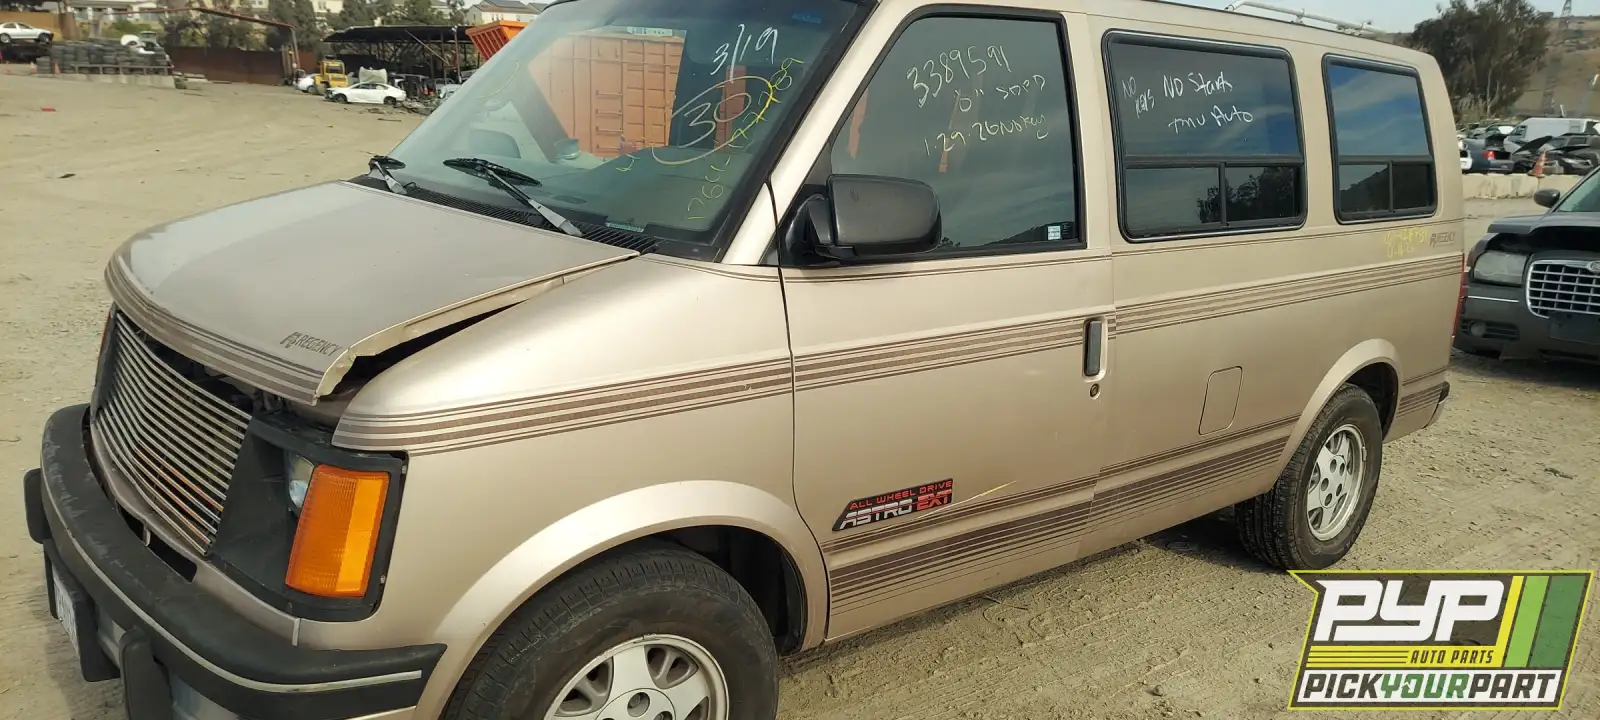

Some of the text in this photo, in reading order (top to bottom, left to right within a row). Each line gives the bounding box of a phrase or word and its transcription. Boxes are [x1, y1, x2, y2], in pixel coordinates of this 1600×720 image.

[710, 23, 778, 83] 3/19
[906, 45, 1012, 108] 3389591
[683, 92, 752, 149] 30
[294, 334, 342, 357] REGENCY
[839, 488, 952, 530] ASTRO EXT
[849, 480, 953, 510] ALL WHEEL DRIVE
